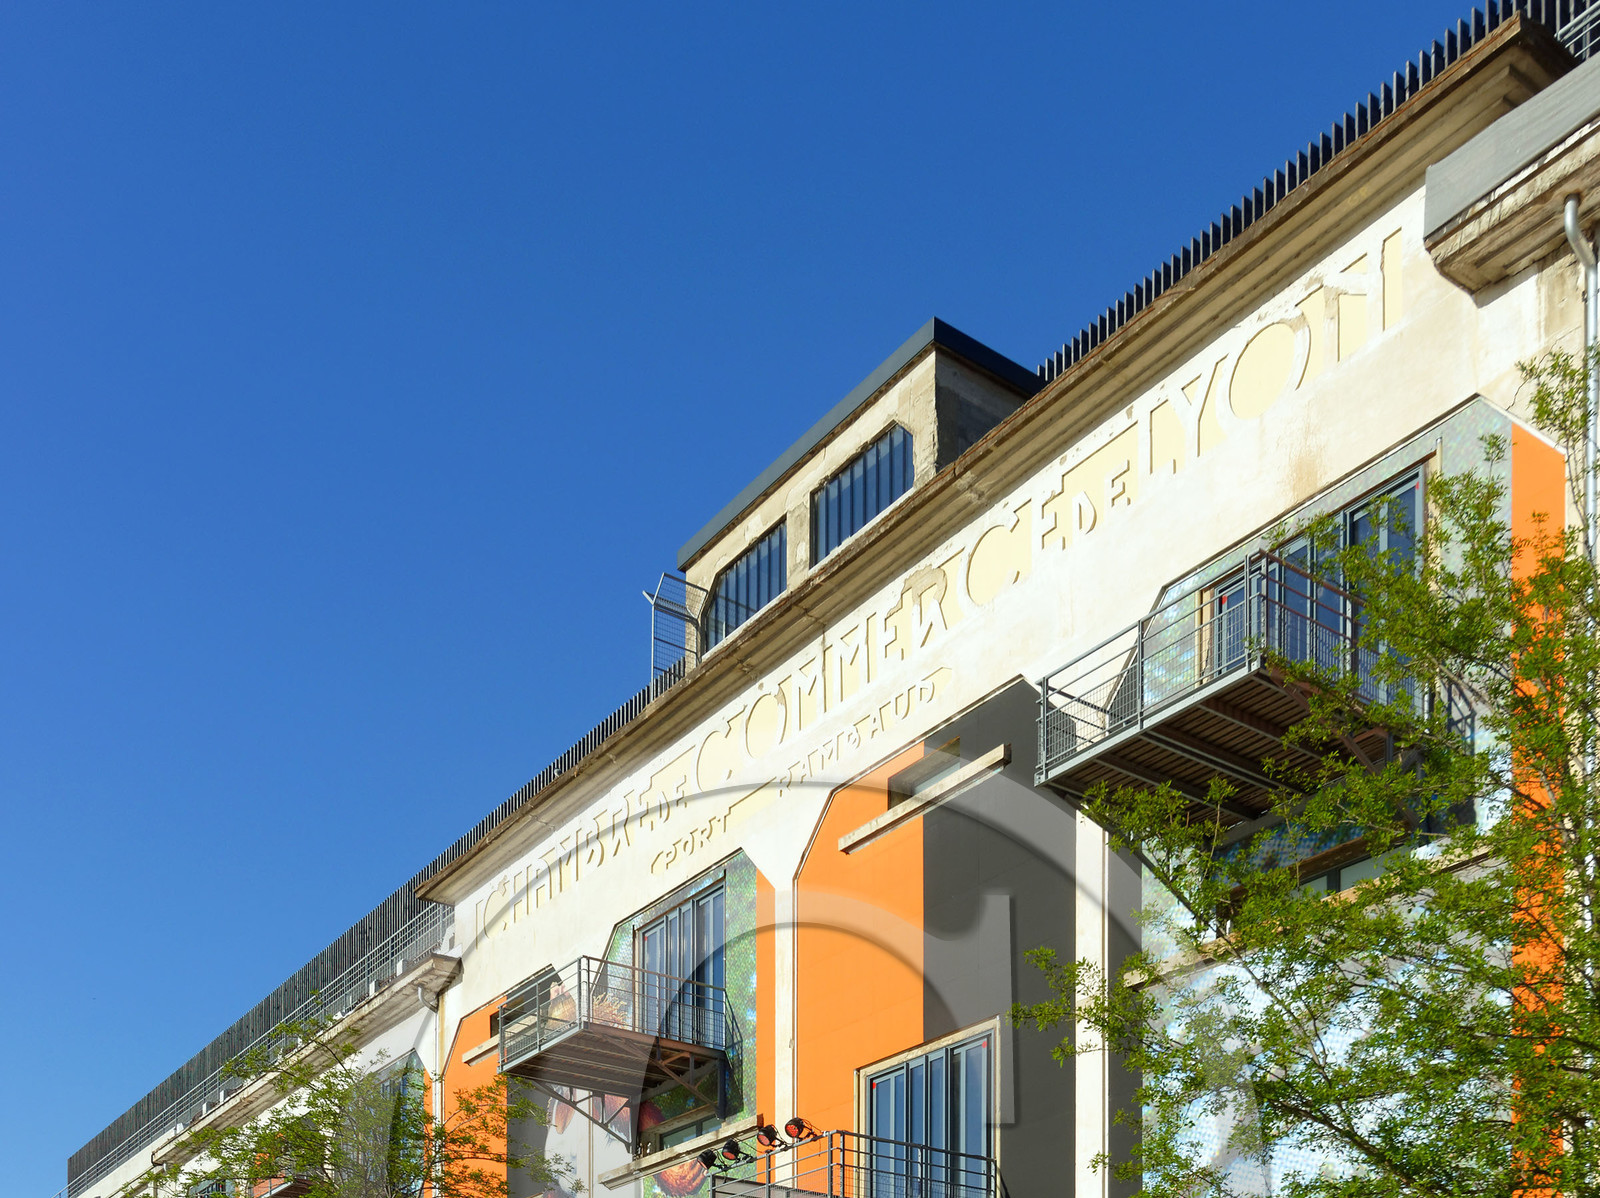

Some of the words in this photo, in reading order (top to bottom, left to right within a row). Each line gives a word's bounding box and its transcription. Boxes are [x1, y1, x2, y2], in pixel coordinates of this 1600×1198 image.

[477, 777, 653, 945] CHAMBRE
[655, 772, 687, 823] DE
[690, 475, 1066, 797] COMMERCE
[1072, 457, 1132, 541] DE
[1140, 238, 1386, 486] LYON
[662, 806, 731, 869] PORT
[775, 681, 935, 797] RAMBAUD
